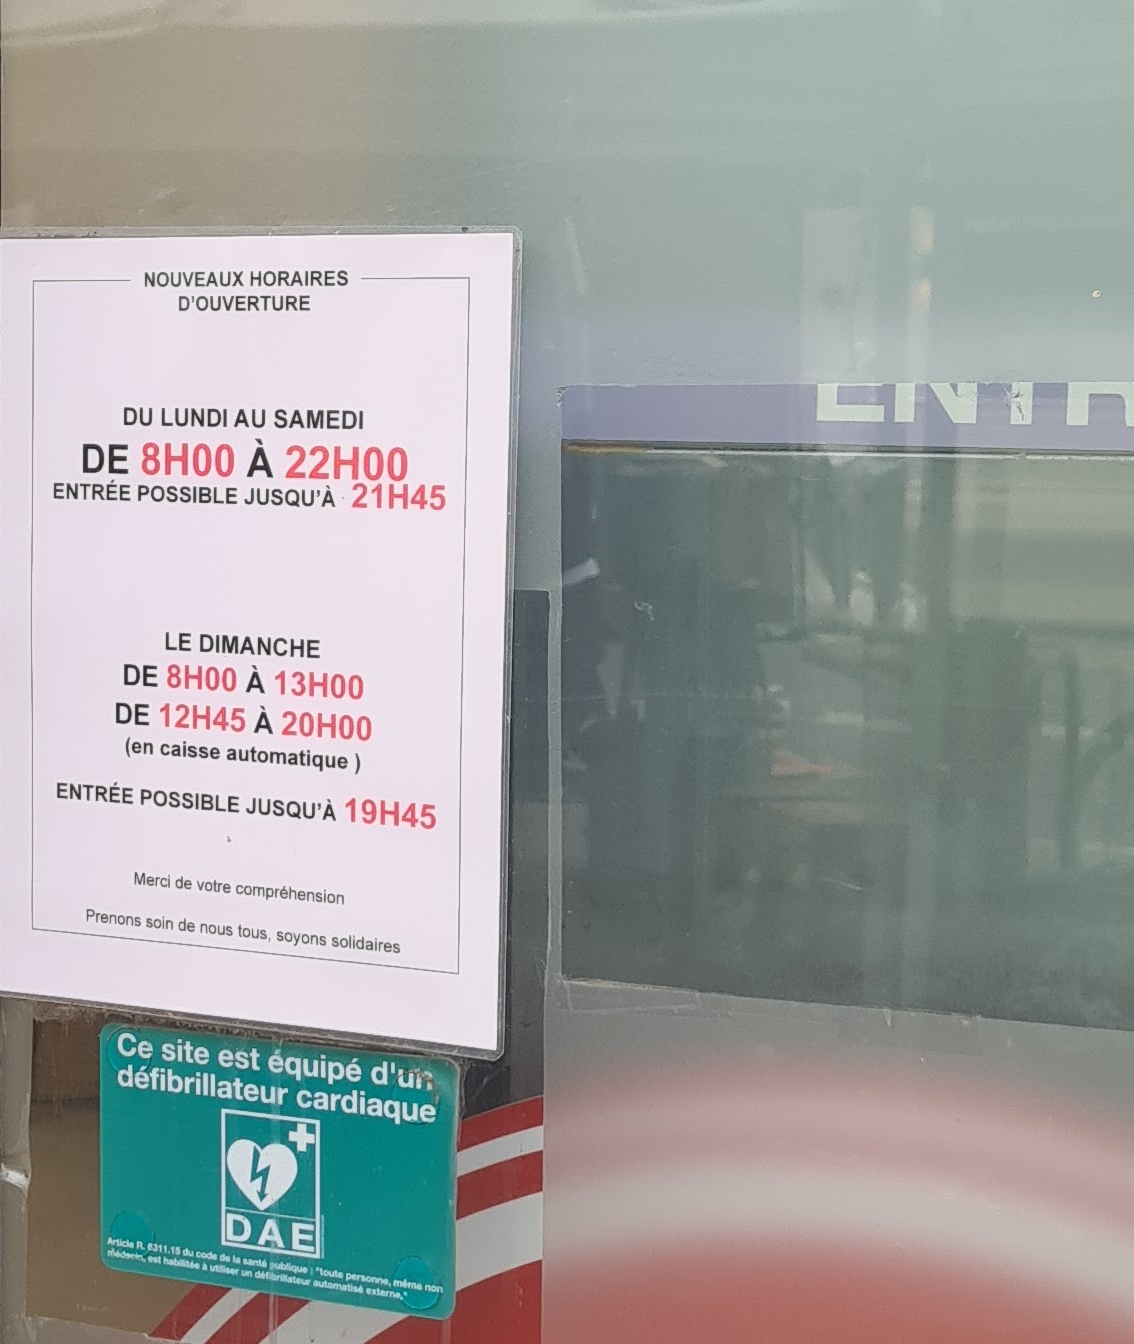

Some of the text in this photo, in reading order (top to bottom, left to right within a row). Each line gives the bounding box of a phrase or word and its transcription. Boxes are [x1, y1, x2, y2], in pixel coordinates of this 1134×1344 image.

[145, 270, 348, 287] NOUVEAUX HORAIRES
[179, 295, 310, 311] D'OUVERTURE
[124, 407, 363, 429] DU LUNDI AU SAMEDI
[83, 438, 408, 481] DE 8H00 À 22H00
[54, 480, 446, 510] ENTRÉE POSSIBLE JUSQU'À 21H45
[166, 632, 320, 658] LE DIMANCHE
[124, 664, 363, 700] DE 8H00 À 13H00
[116, 702, 371, 741] DE 12H45 À 20H00
[126, 737, 153, 757] (en
[160, 741, 220, 759] caisse
[227, 746, 348, 772] automatique
[57, 782, 436, 829] ENTRÉE POSSIBLE JUSQU'À 19H45
[134, 872, 344, 905] Merci de votre compréhension
[86, 909, 400, 953] Prenons soin de nous tous, soyons solidaires
[117, 1033, 433, 1090] Ce site est équipé d'un
[118, 1064, 439, 1124] défibrillateur cardiaque
[226, 1213, 316, 1252] DAE
[107, 1236, 134, 1249] Article
[136, 1240, 144, 1251] R.
[182, 1247, 193, 1257] du
[196, 1248, 217, 1260] code
[219, 1251, 231, 1262] de
[233, 1253, 241, 1263] la
[243, 1255, 267, 1267] santé
[346, 1270, 391, 1287] personne,
[393, 1275, 422, 1290] même
[424, 1283, 443, 1293] non
[147, 1255, 161, 1264] est
[163, 1255, 200, 1270] habilitée
[210, 1262, 239, 1274] utiliser
[242, 1268, 252, 1276] un
[255, 1268, 310, 1286] défibrillateur
[313, 1277, 363, 1294] automatisé
